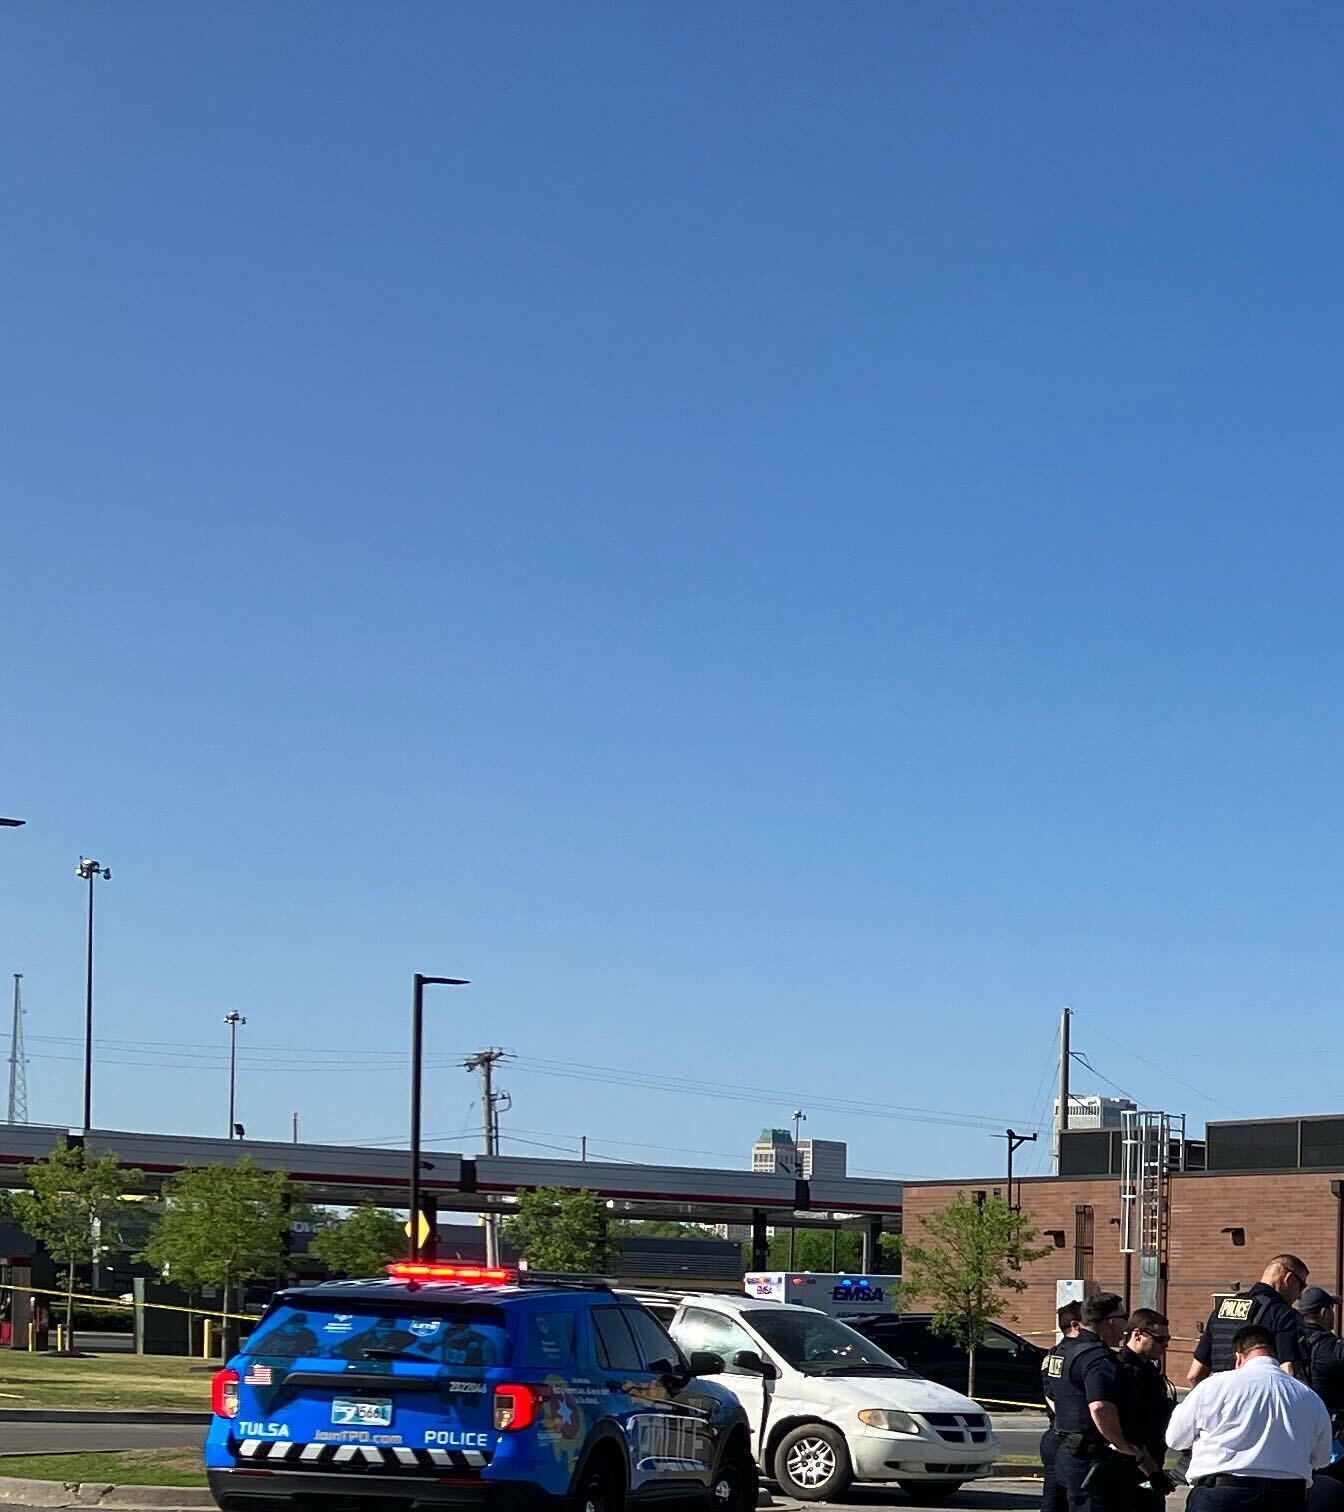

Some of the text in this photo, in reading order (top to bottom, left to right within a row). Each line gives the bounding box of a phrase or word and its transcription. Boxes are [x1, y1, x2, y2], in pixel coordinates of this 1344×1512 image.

[833, 1286, 884, 1301] EMSA
[1219, 1301, 1249, 1318] POLICE
[239, 1421, 289, 1437] TULSA
[425, 1430, 488, 1446] POLICE
